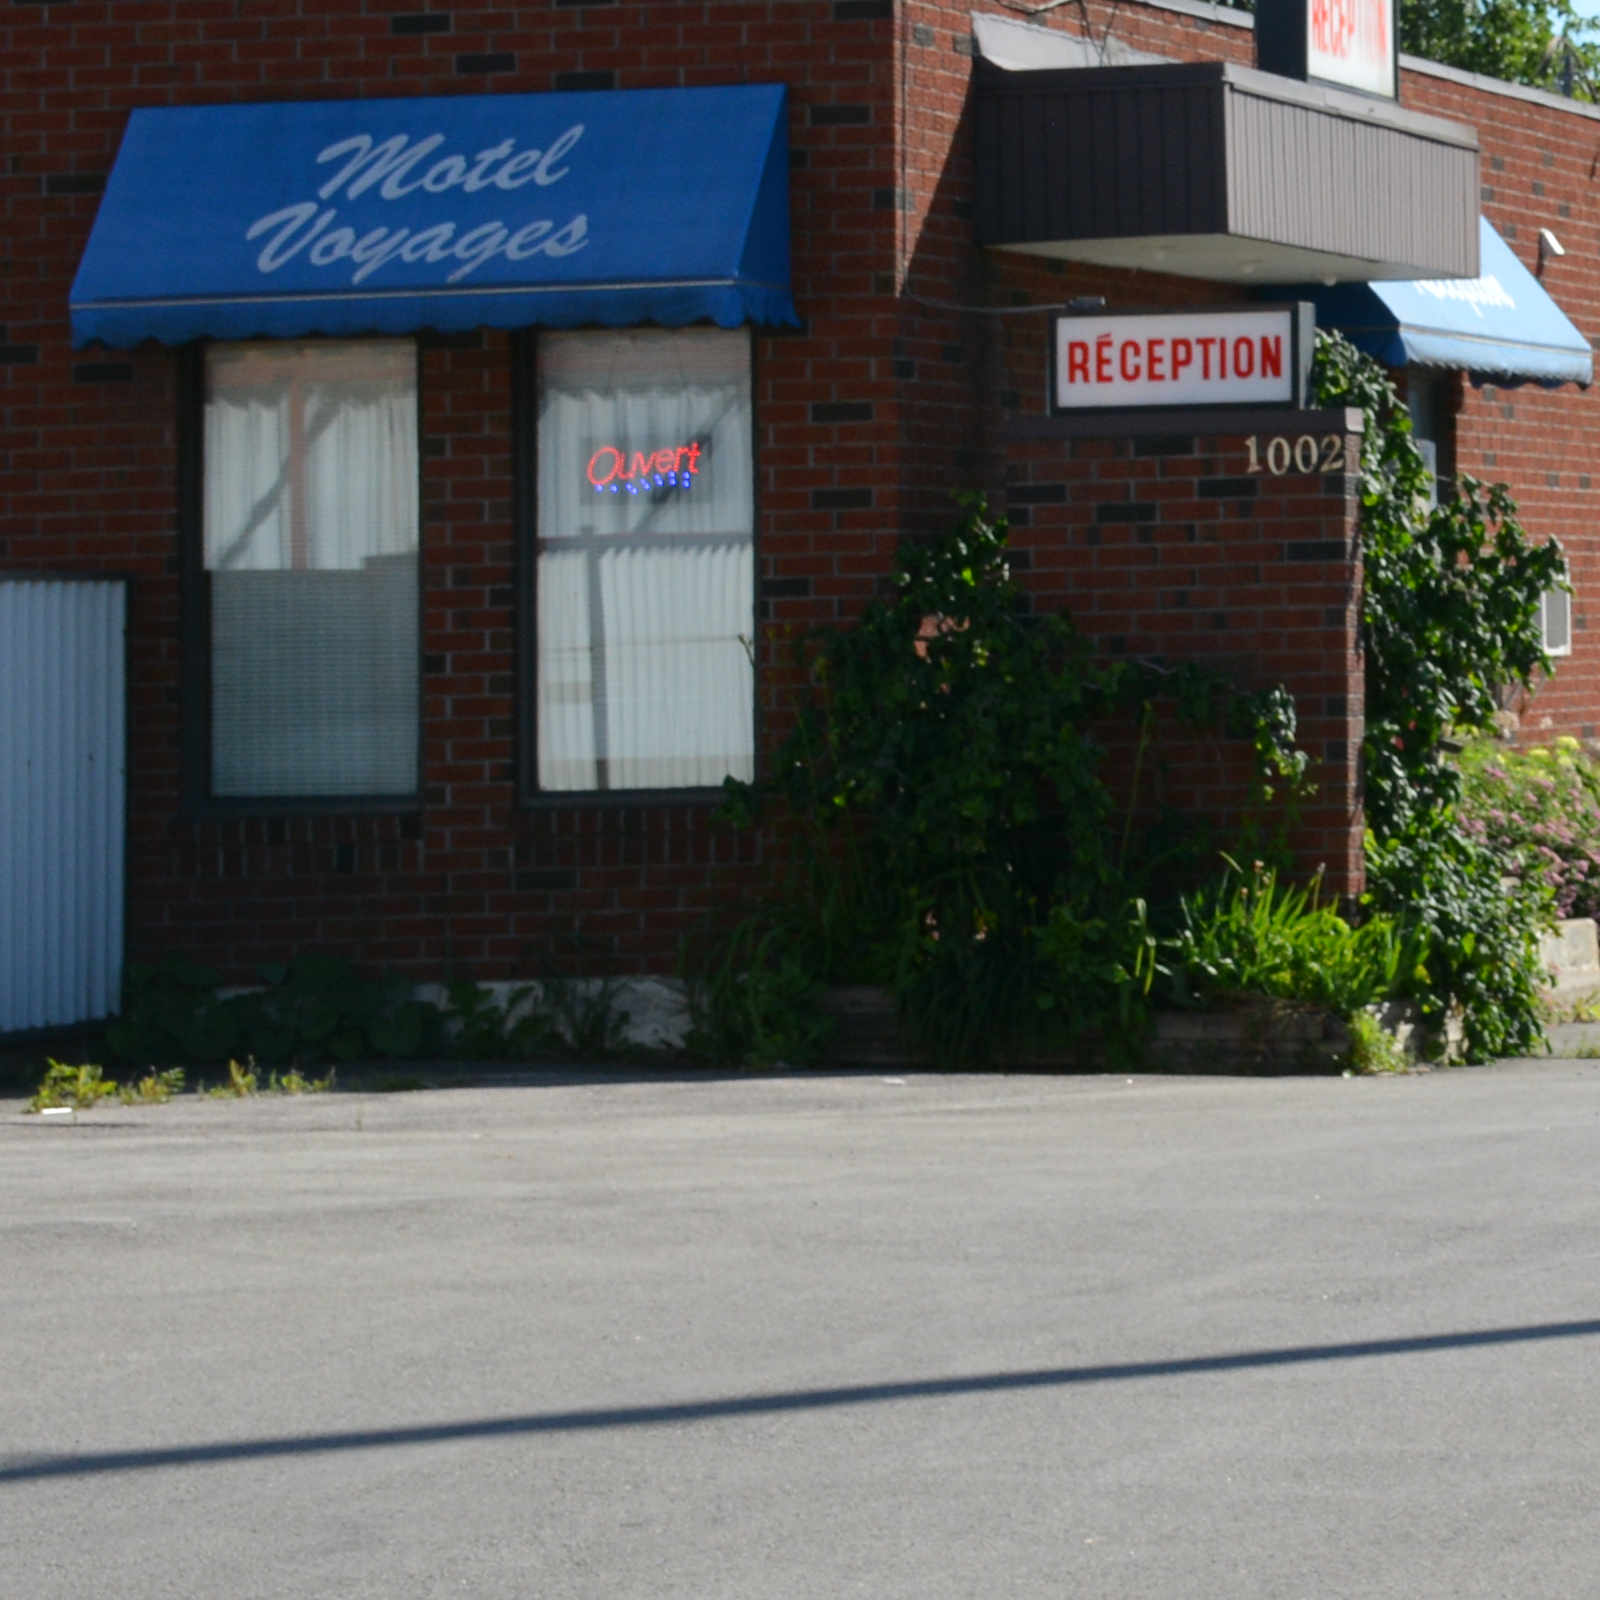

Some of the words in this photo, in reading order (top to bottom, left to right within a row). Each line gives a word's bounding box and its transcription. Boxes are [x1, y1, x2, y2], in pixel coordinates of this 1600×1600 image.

[316, 124, 585, 200] Motel
[246, 201, 589, 285] Voyages
[1067, 333, 1283, 384] RÉCEPTION
[587, 442, 701, 486] Ouvert
[1244, 434, 1345, 476] 1002
